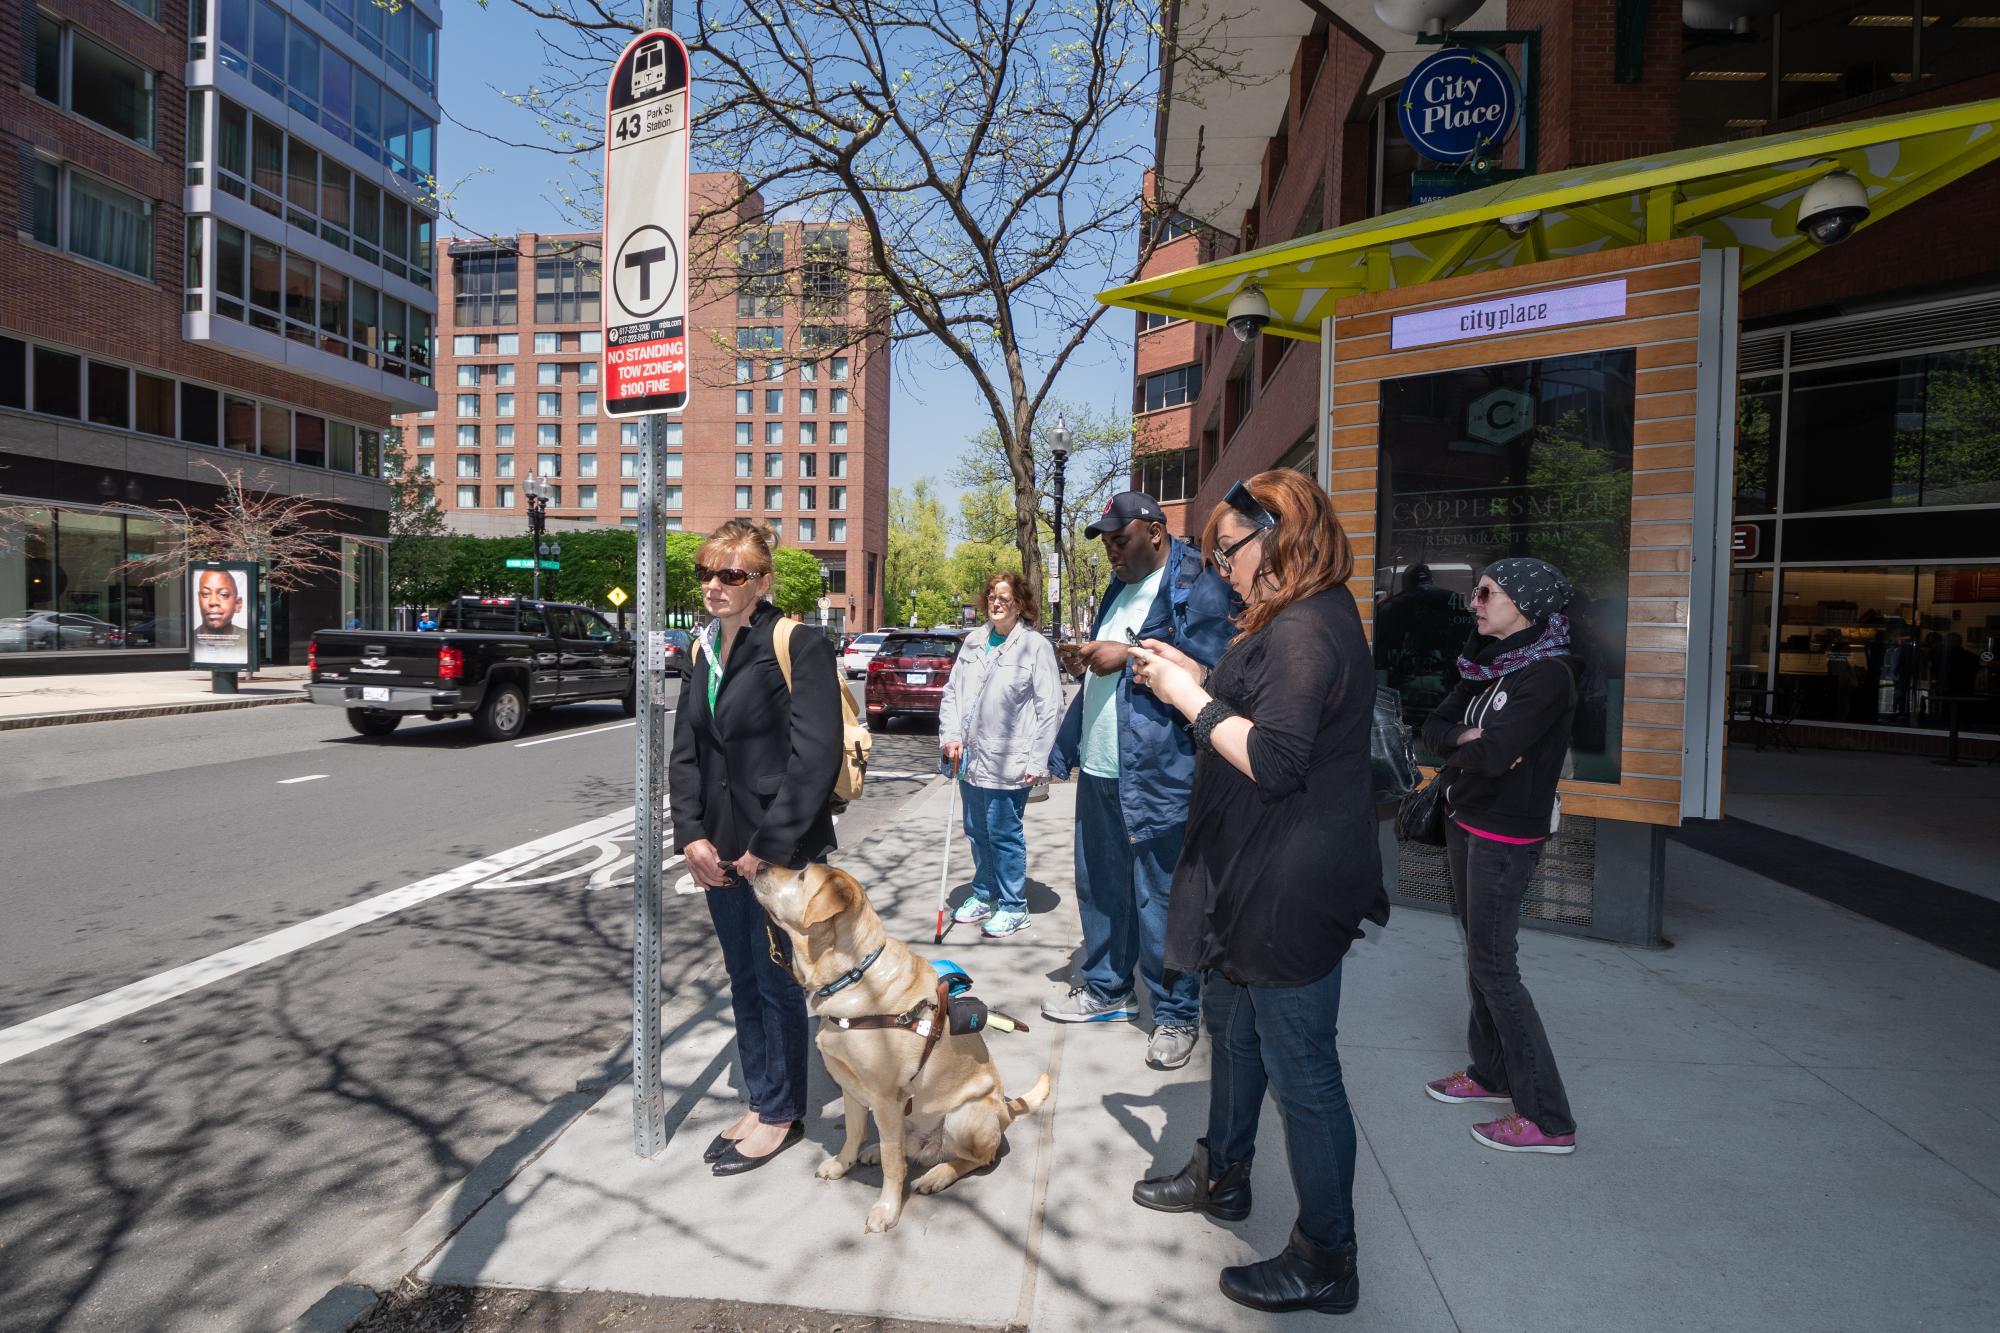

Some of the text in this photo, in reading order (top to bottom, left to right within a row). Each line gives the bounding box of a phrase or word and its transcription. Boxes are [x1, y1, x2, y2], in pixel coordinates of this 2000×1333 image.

[1424, 75, 1482, 106] City
[647, 104, 674, 119] Park St.
[1422, 103, 1501, 135] Place
[616, 113, 641, 141] 43
[647, 118, 671, 132] Station
[624, 245, 666, 302] T
[650, 330, 665, 339] (TTY)
[659, 320, 682, 329] mbta.com
[607, 341, 684, 365] NO STANDING
[618, 360, 673, 380] TOW ZONE
[620, 378, 670, 396] $100 FINE
[1486, 400, 1516, 430] C
[1391, 490, 1614, 523] COPPERSMITH
[1425, 528, 1520, 546] RESTAURANT
[1540, 529, 1571, 543] BAR
